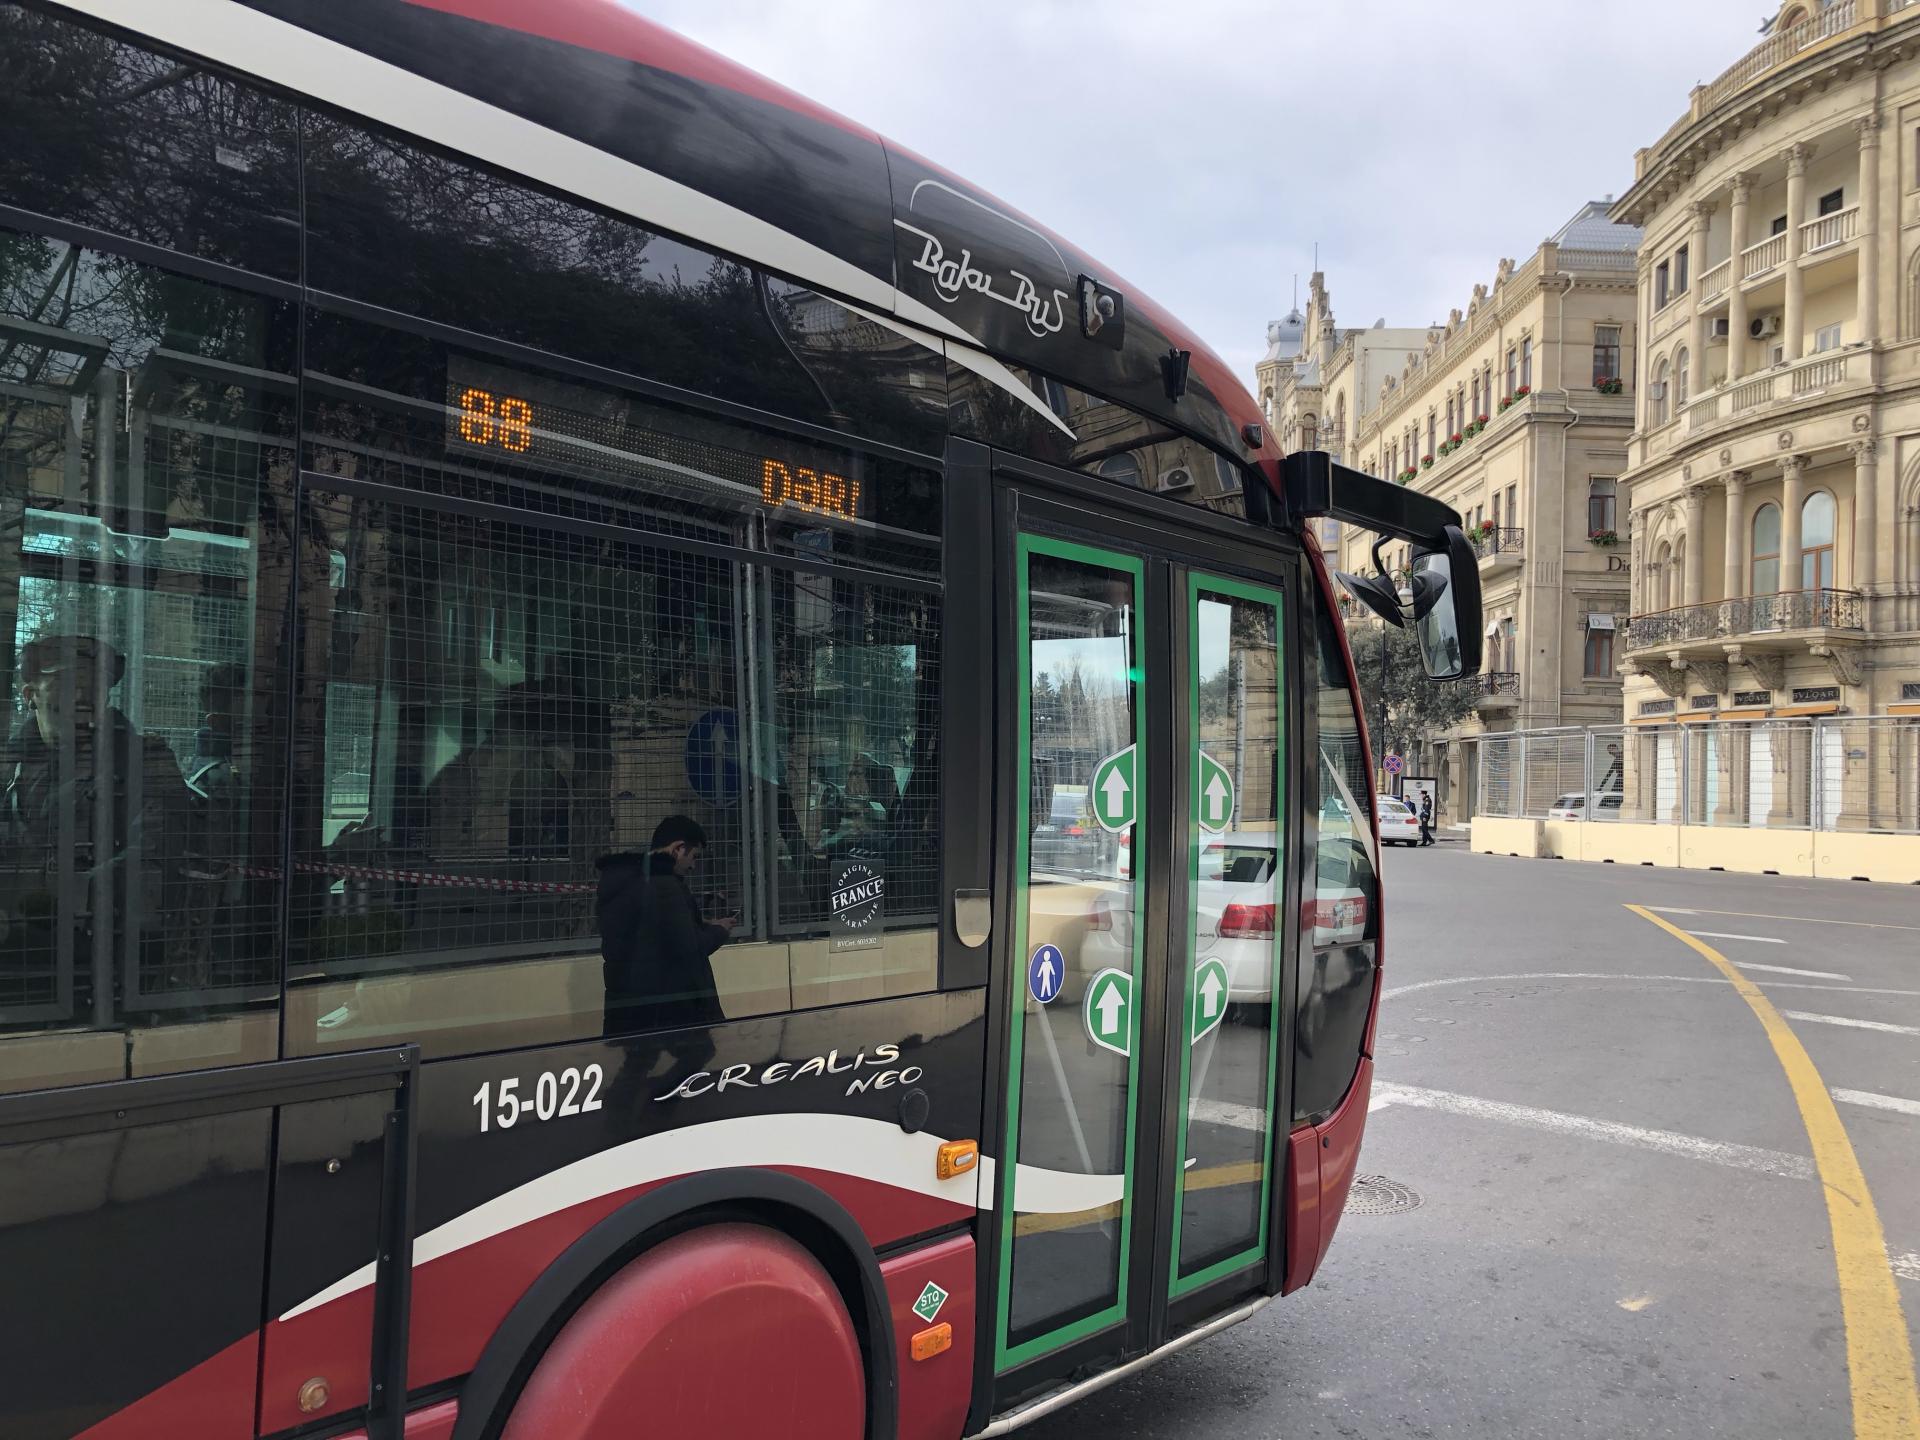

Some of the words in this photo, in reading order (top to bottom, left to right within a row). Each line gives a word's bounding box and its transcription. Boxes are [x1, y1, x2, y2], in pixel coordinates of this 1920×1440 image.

[898, 224, 992, 302] Baku
[1010, 270, 1068, 337] Bus
[461, 388, 532, 452] 88
[838, 864, 873, 887] ORIGINE
[831, 880, 882, 911] FRANCE
[840, 902, 879, 929] GARANTIE
[845, 1066, 922, 1097] NEO
[473, 1063, 603, 1133] 15-022
[921, 1290, 940, 1308] STQ
